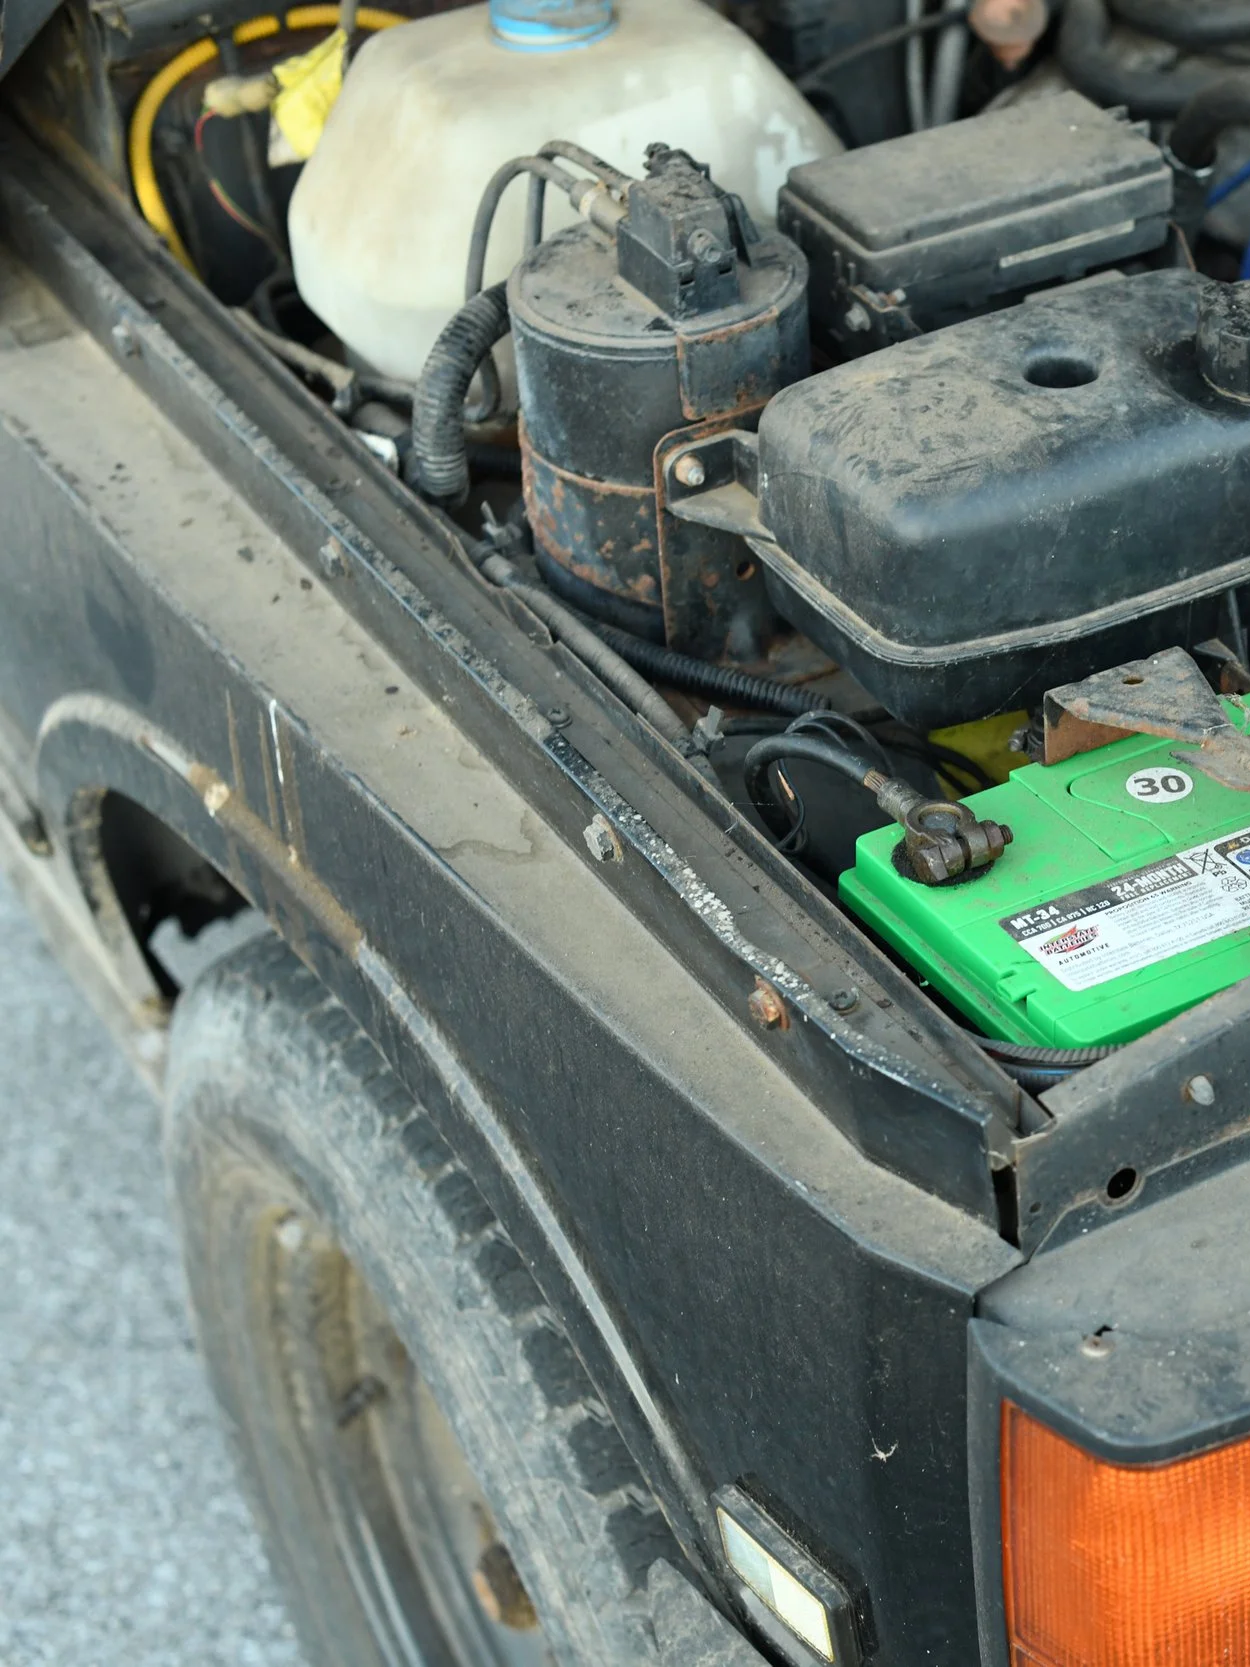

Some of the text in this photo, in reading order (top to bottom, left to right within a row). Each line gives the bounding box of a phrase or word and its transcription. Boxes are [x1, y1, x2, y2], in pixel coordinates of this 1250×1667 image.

[1133, 775, 1186, 796] 30
[1111, 863, 1188, 897] 24-MONTH
[1010, 905, 1060, 930] MT-34
[1022, 928, 1038, 937] CCA
[1057, 916, 1068, 924] CA
[1086, 904, 1097, 913] RC
[1039, 926, 1095, 952] INTERSTATE
[1046, 932, 1098, 956] BATTERIES
[1058, 942, 1110, 966] AUTOMOTIVE
